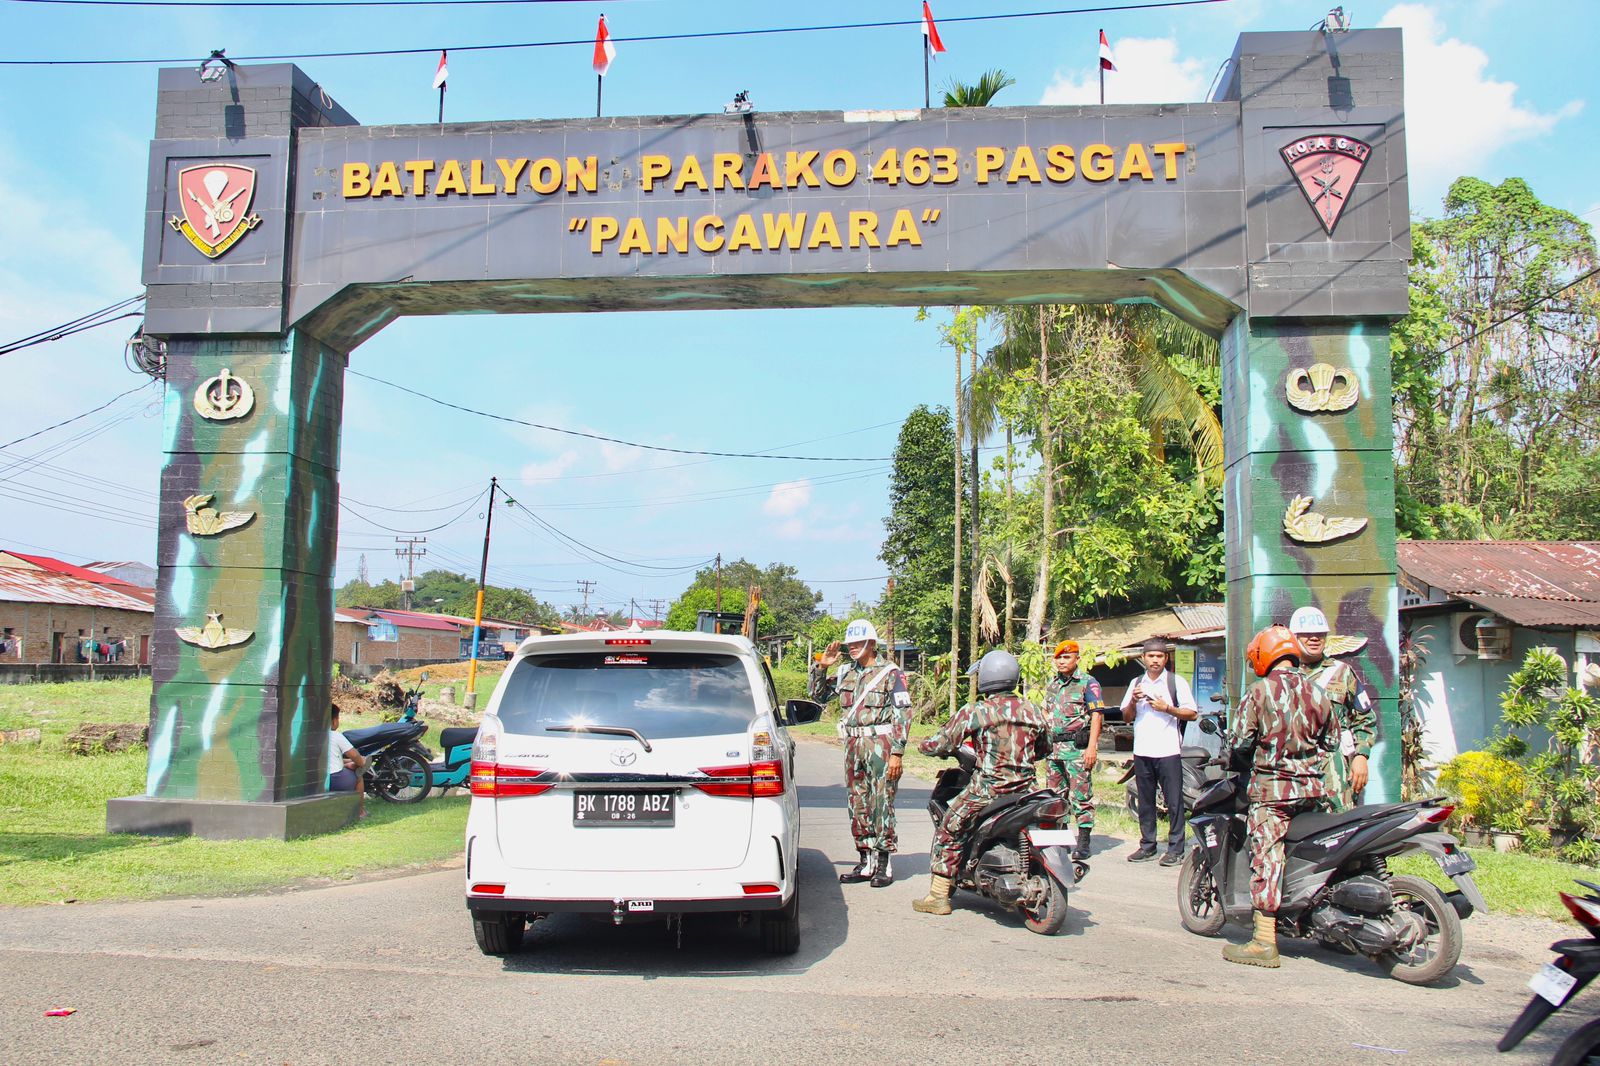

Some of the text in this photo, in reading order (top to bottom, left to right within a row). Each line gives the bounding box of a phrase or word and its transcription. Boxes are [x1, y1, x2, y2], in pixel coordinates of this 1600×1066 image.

[1286, 137, 1366, 158] KOPASGAT
[342, 142, 1188, 199] BATALYON PARAKO 463 PASGAT
[578, 795, 670, 812] BK 1788 ABZ
